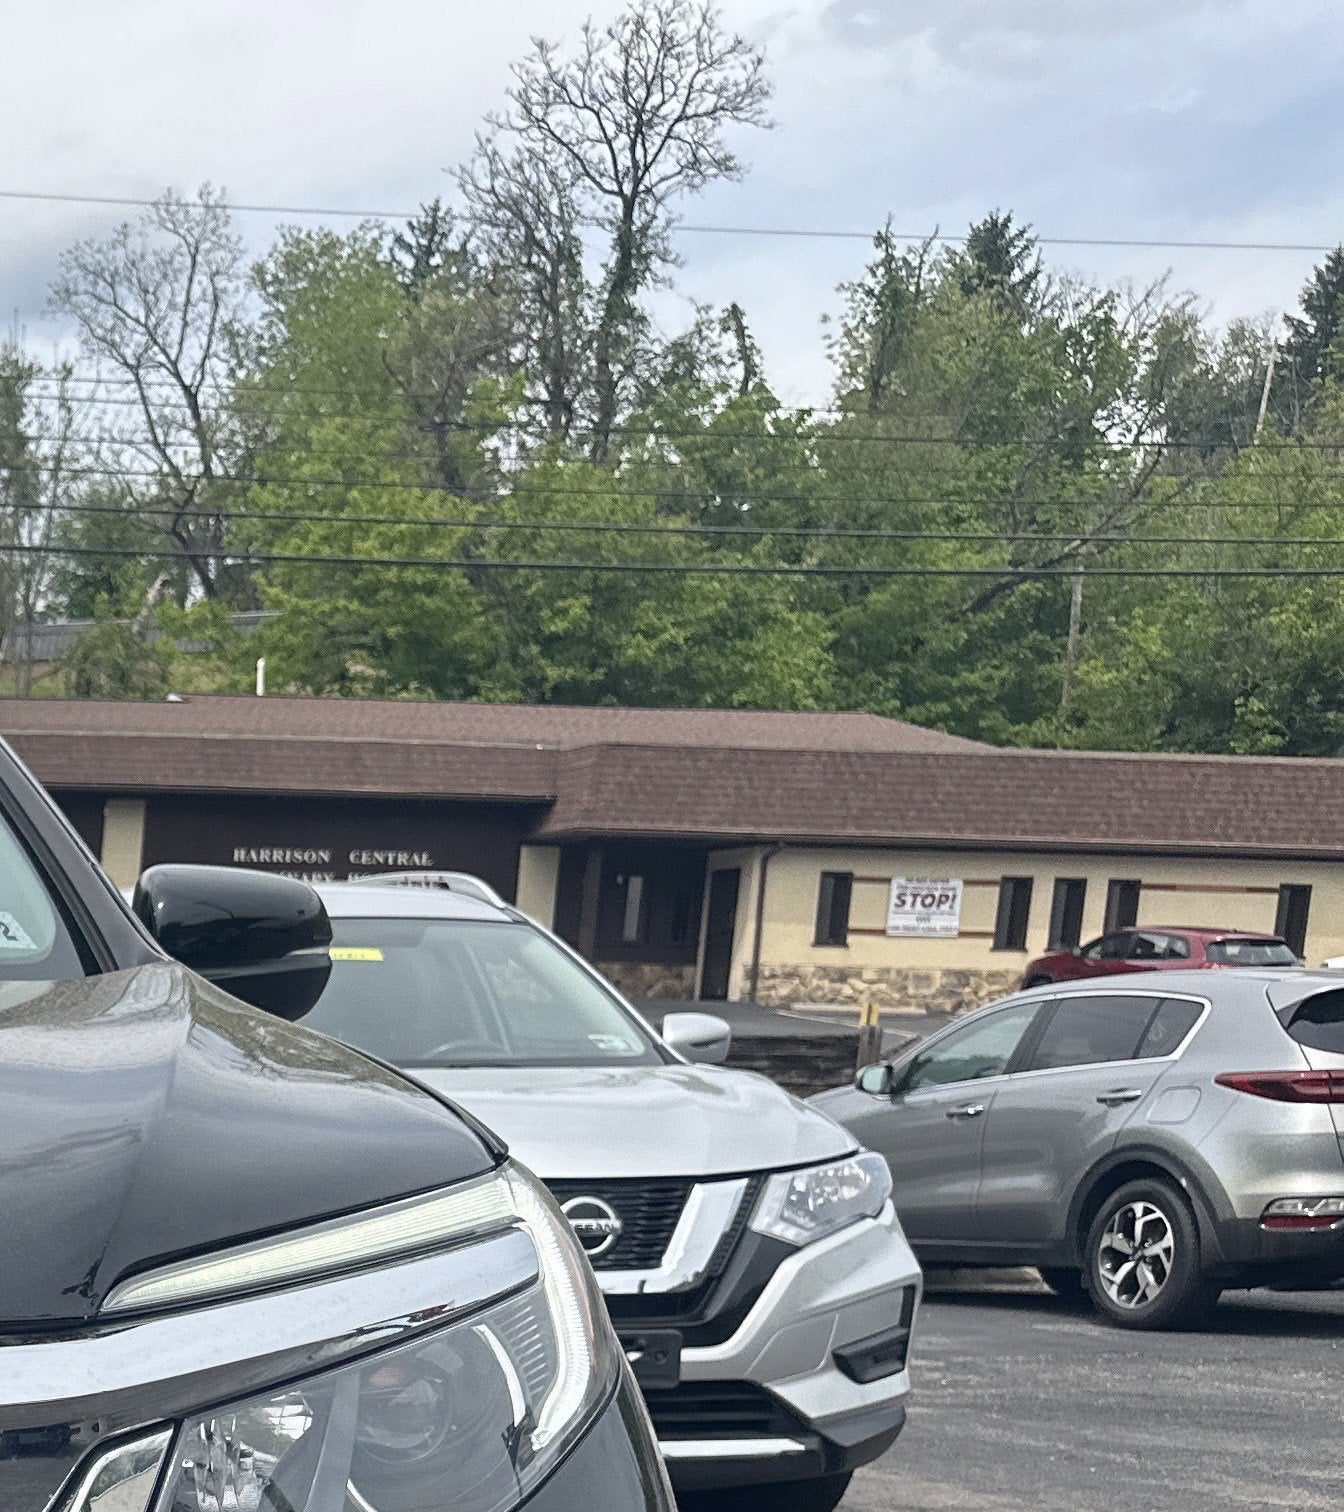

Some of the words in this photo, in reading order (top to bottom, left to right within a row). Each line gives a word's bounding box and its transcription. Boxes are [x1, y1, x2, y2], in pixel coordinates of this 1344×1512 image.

[232, 847, 331, 864] HARRISON
[349, 850, 434, 867] CENTRAL
[894, 892, 957, 911] STOP!
